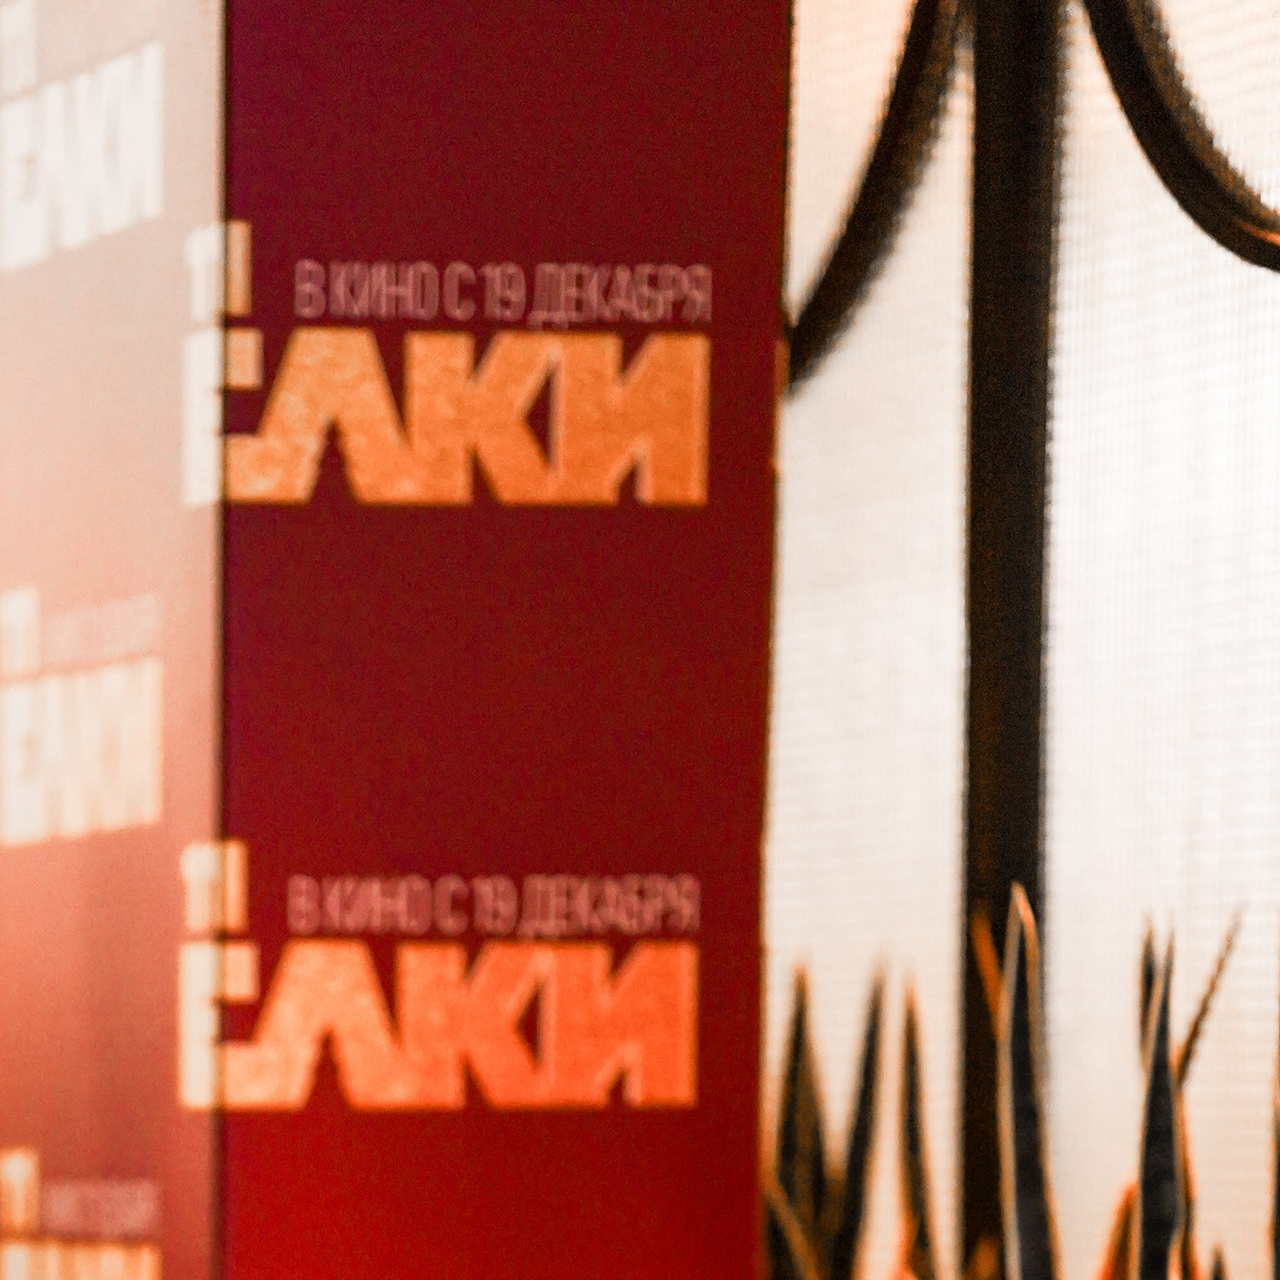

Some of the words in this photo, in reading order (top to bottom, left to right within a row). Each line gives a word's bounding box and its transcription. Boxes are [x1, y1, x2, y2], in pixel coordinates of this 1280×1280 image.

[294, 258, 326, 320] В
[328, 260, 440, 321] КИНО
[442, 261, 477, 322] С
[478, 261, 527, 323] 19
[528, 261, 713, 331] ДЕКАБРЯ
[286, 873, 320, 935] В
[321, 873, 433, 936] КИНО
[433, 873, 469, 935] С
[471, 873, 517, 935] 19
[518, 872, 702, 939] ДЕКАБРЯ
